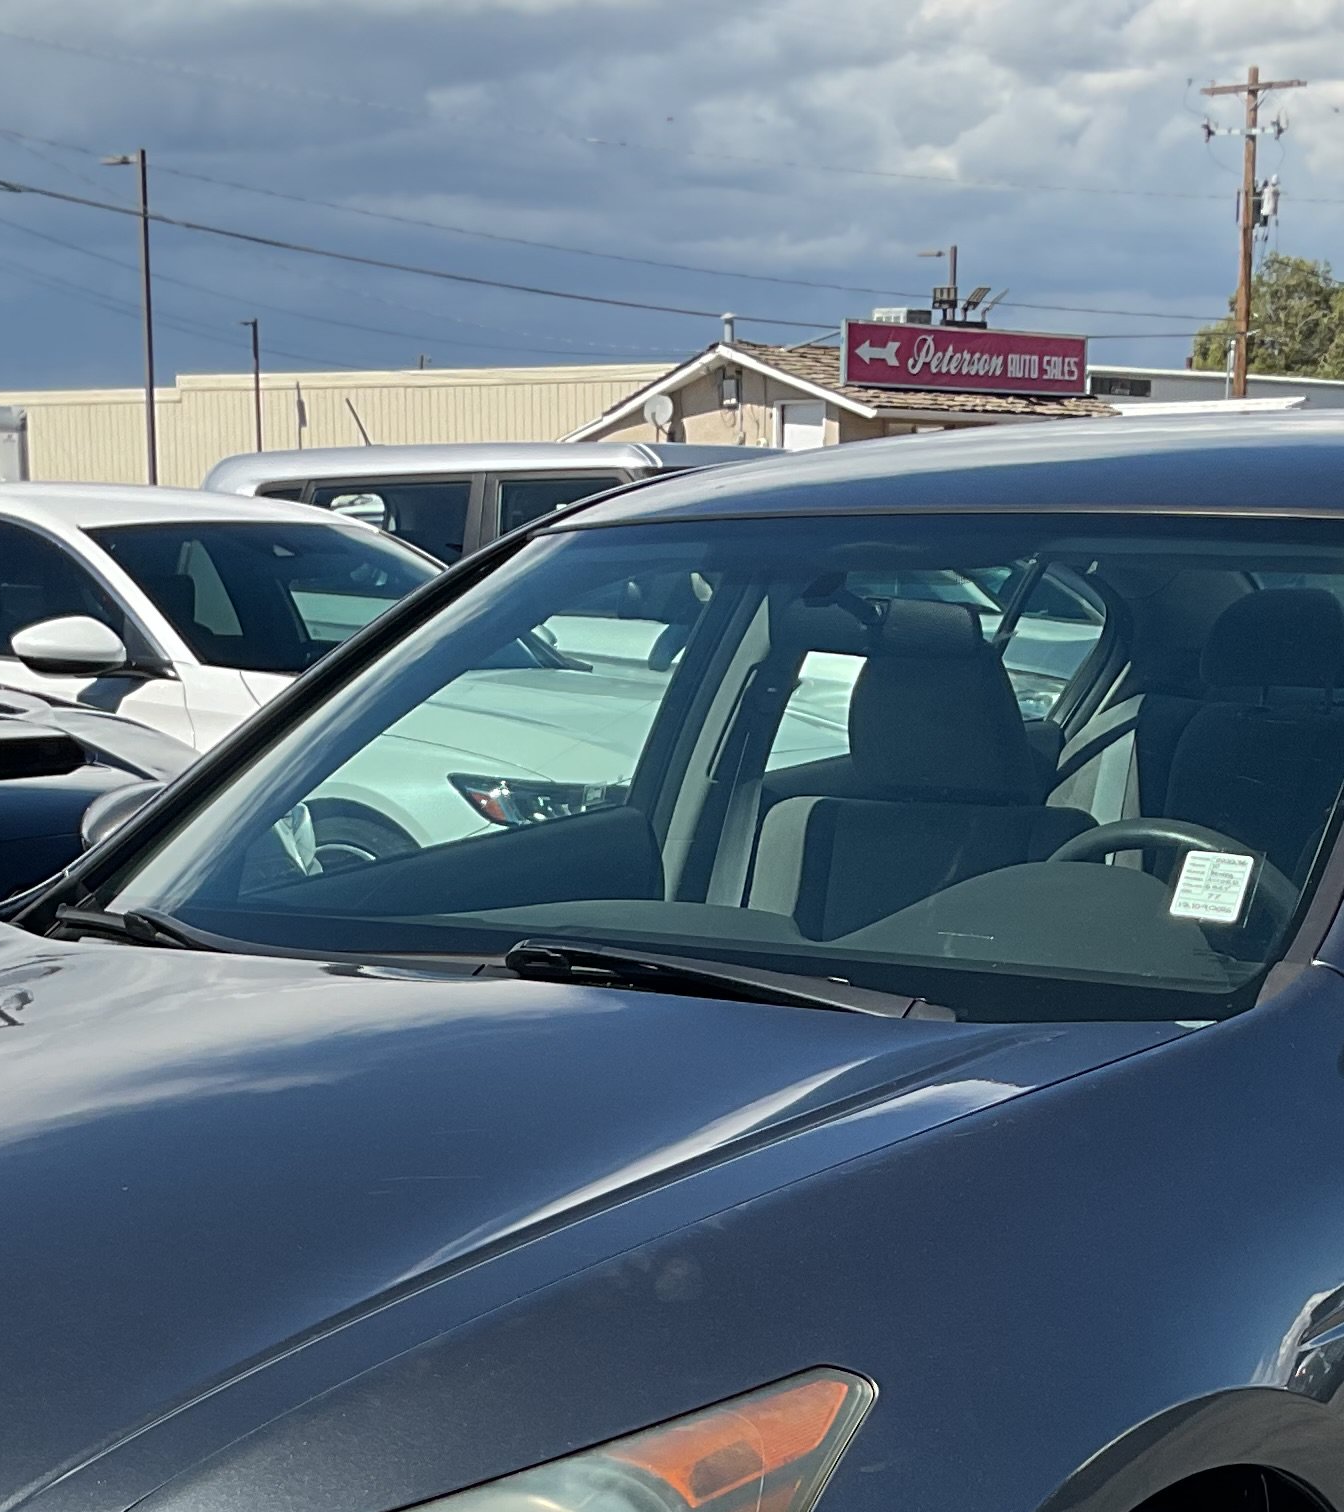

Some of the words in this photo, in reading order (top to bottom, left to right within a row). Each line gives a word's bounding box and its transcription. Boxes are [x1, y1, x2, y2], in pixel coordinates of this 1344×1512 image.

[907, 334, 1004, 377] Peterson
[1007, 354, 1039, 379] AUTO
[1042, 356, 1079, 381] SALES
